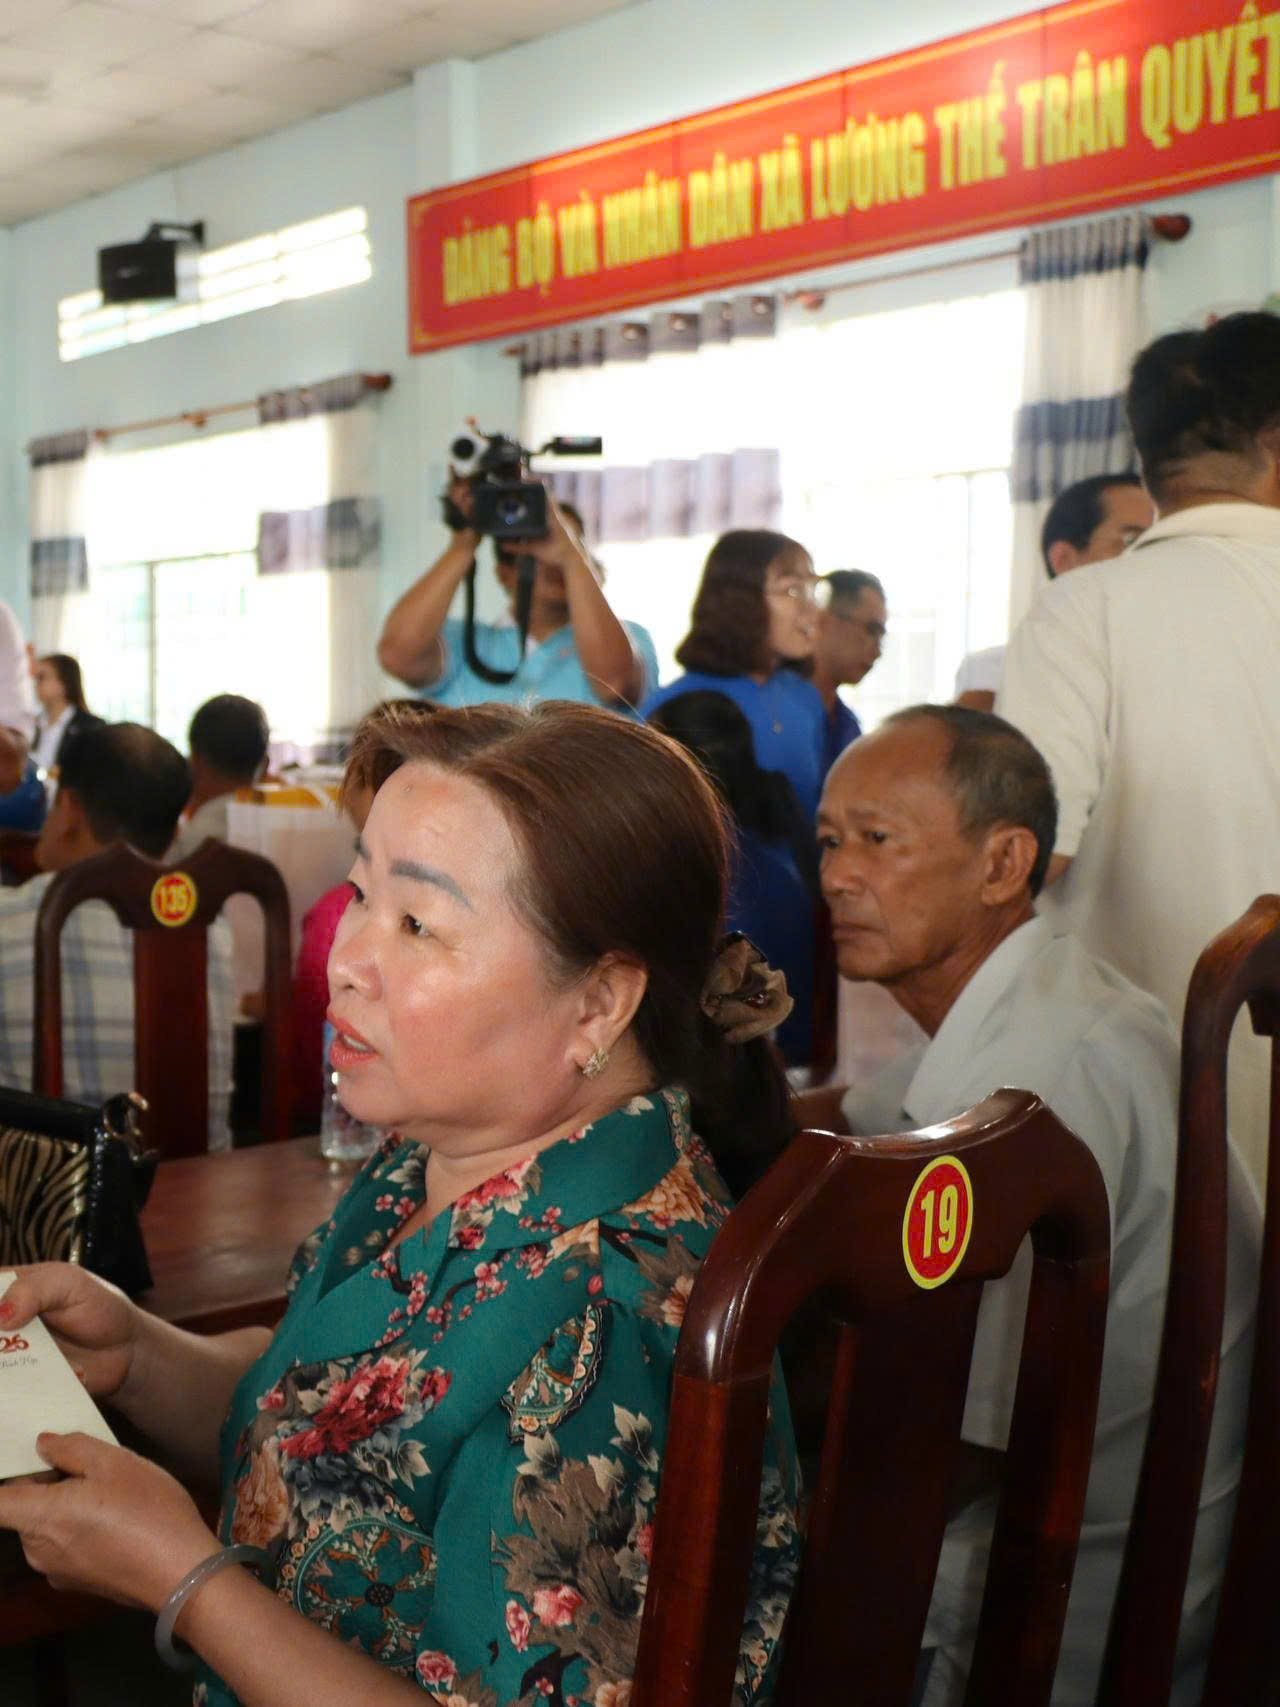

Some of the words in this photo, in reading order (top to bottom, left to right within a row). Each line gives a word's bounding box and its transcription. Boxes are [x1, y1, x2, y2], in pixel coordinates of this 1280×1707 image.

[556, 186, 599, 280] VÀ
[601, 168, 683, 270] NHÂN
[688, 150, 754, 249] DÂN
[758, 132, 806, 233] XÃ
[809, 111, 926, 220] LƯƠNG
[933, 58, 1008, 190] THẾ
[1016, 48, 1129, 170] TRÂN
[920, 1184, 959, 1260] 19
